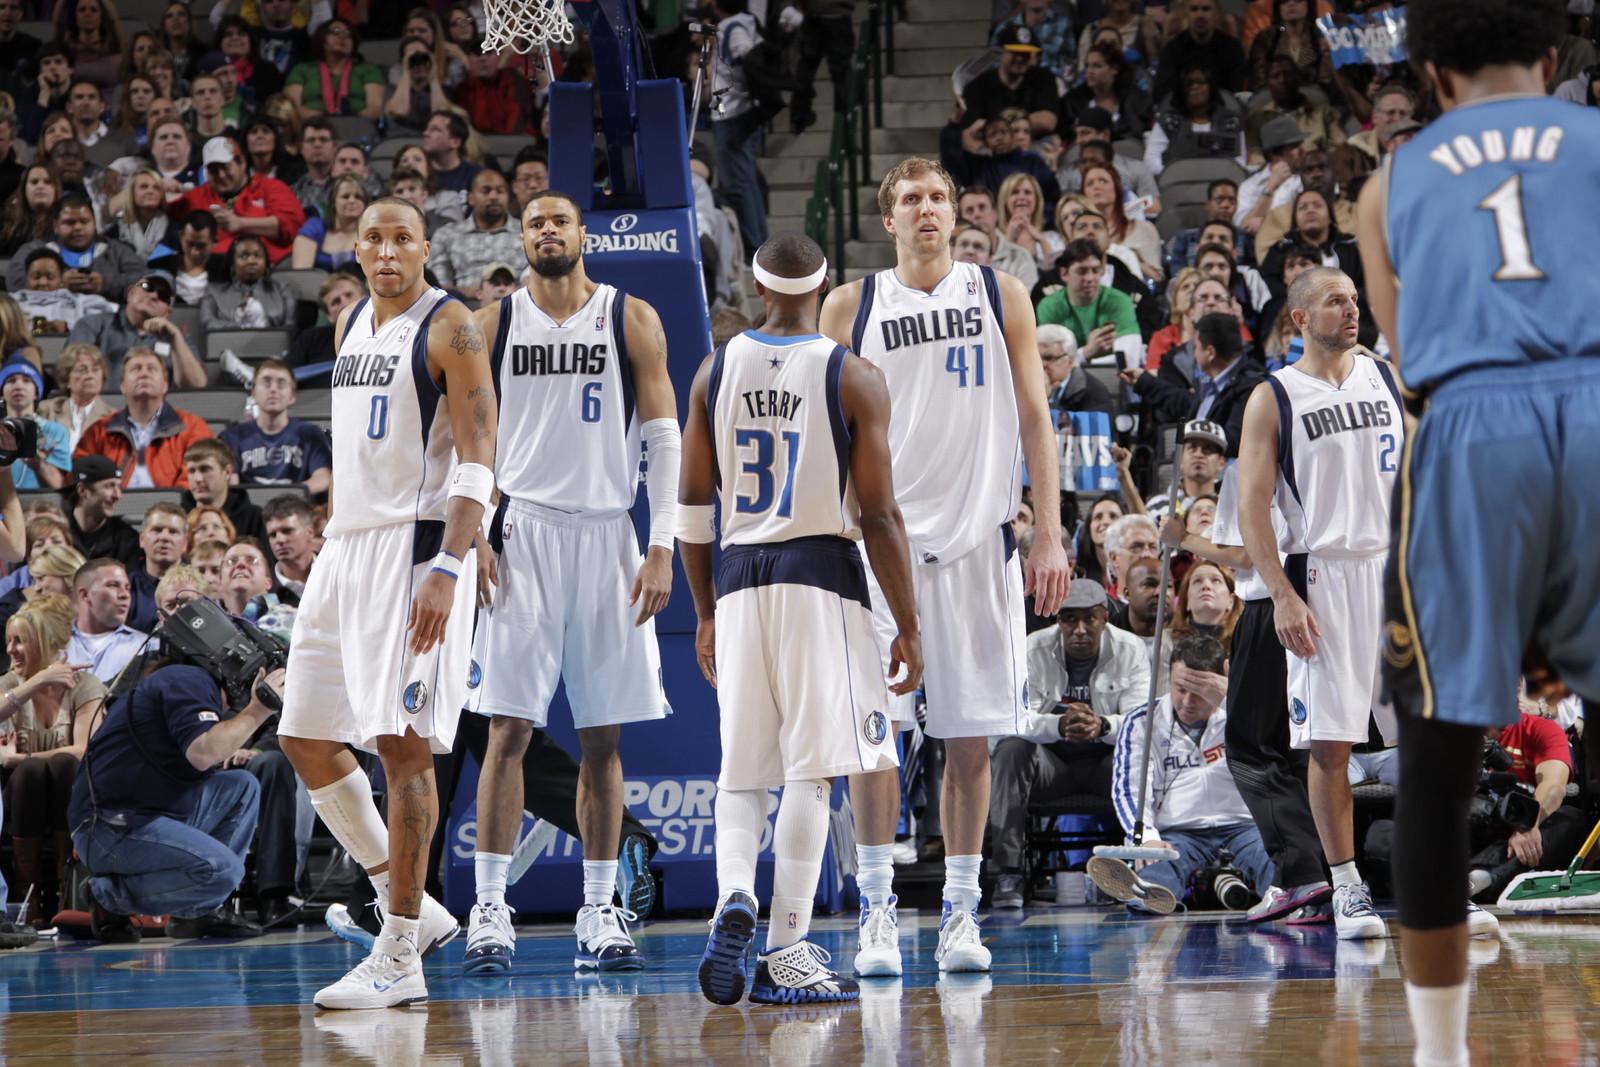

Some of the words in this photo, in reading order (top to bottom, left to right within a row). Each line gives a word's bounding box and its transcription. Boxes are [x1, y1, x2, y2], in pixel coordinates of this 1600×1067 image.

[1429, 125, 1564, 176] YOUNG
[1477, 173, 1548, 280] 1
[881, 306, 983, 352] DALLAS
[333, 355, 401, 388] DALLAS
[512, 344, 608, 377] DALLAS
[945, 344, 985, 389] 41
[367, 394, 389, 440] 0
[581, 381, 603, 424] 6
[742, 389, 803, 421] TERRY
[1301, 400, 1392, 441] DALLAS
[734, 427, 801, 520] 31
[1379, 433, 1397, 473] 2
